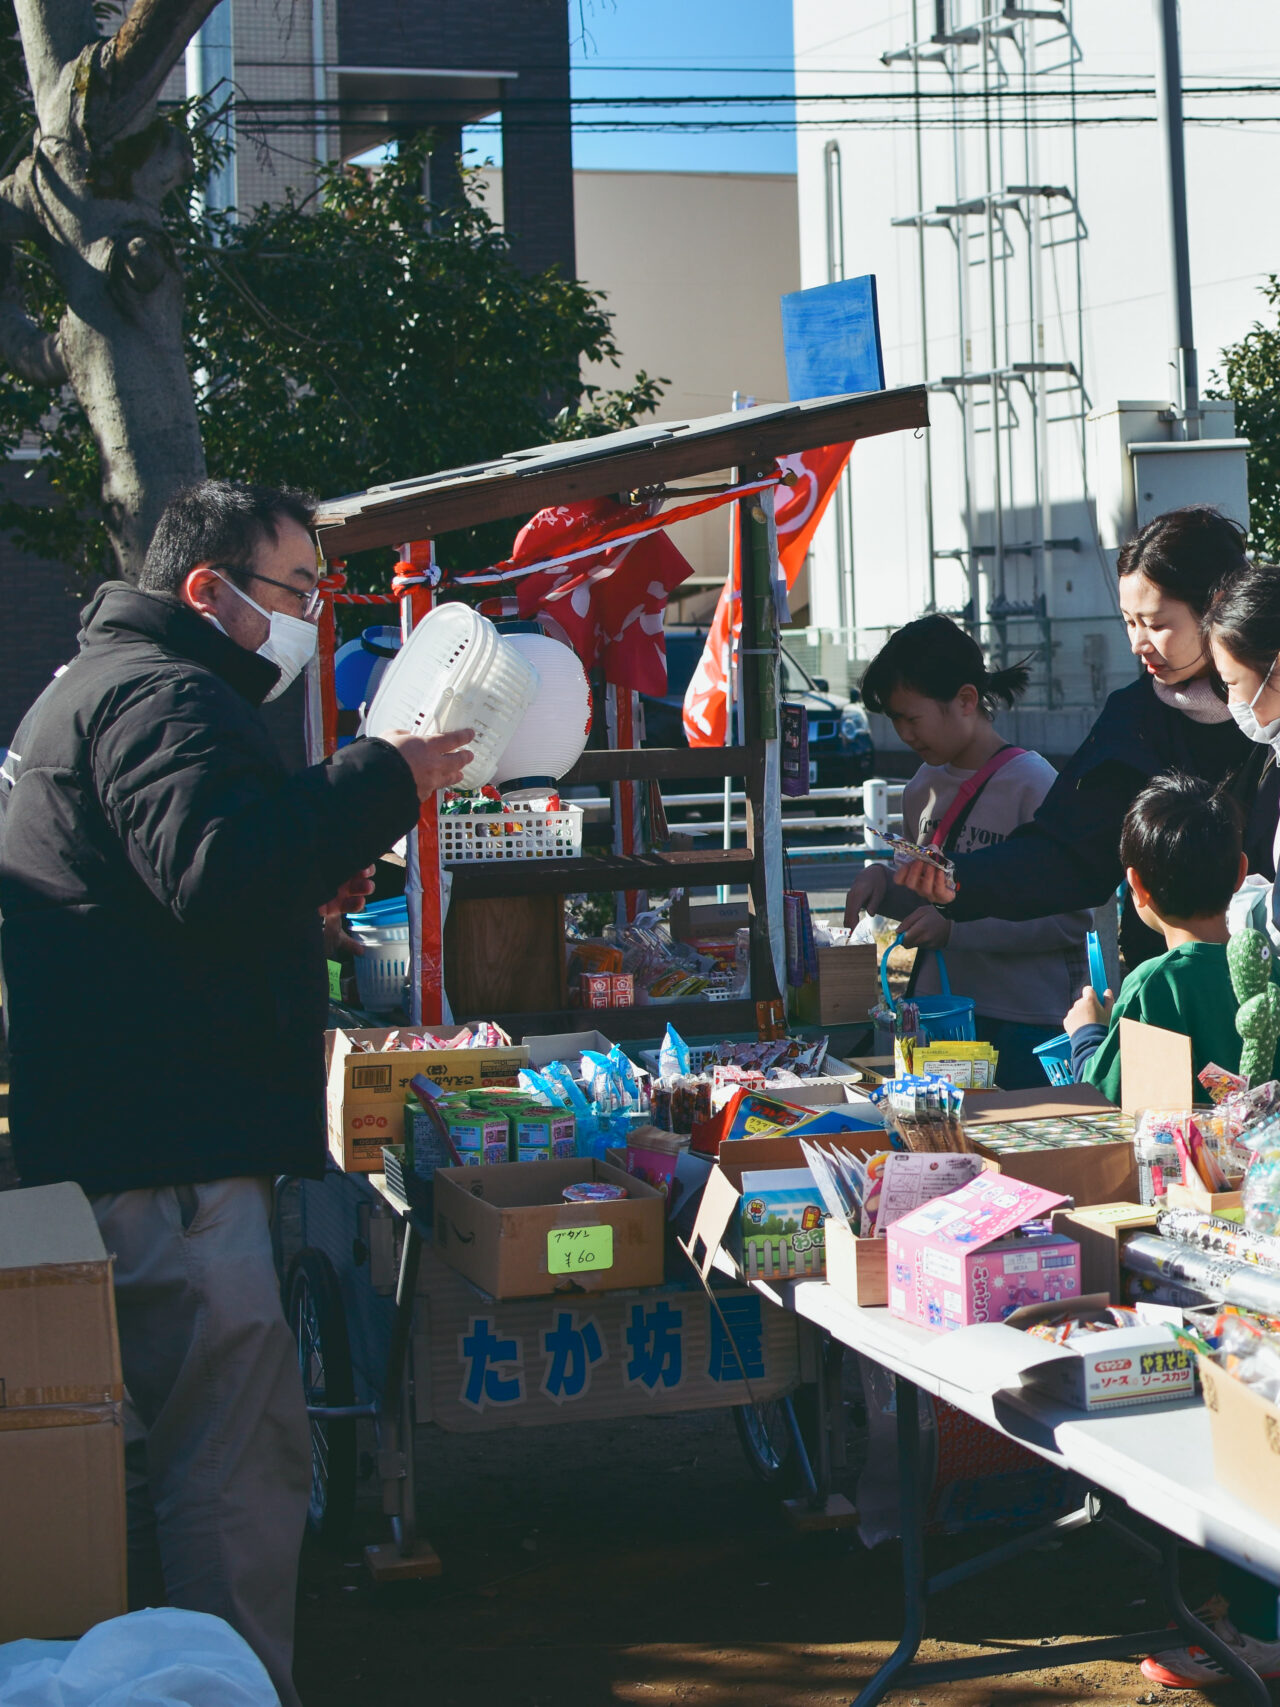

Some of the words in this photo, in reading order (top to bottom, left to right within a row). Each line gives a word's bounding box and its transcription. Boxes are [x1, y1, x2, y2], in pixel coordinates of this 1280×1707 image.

[461, 1294, 765, 1405] たか坊屋
[1141, 1352, 1190, 1374] やきそば
[1101, 1375, 1129, 1388] ソース
[1142, 1370, 1190, 1387] ソースカツ
